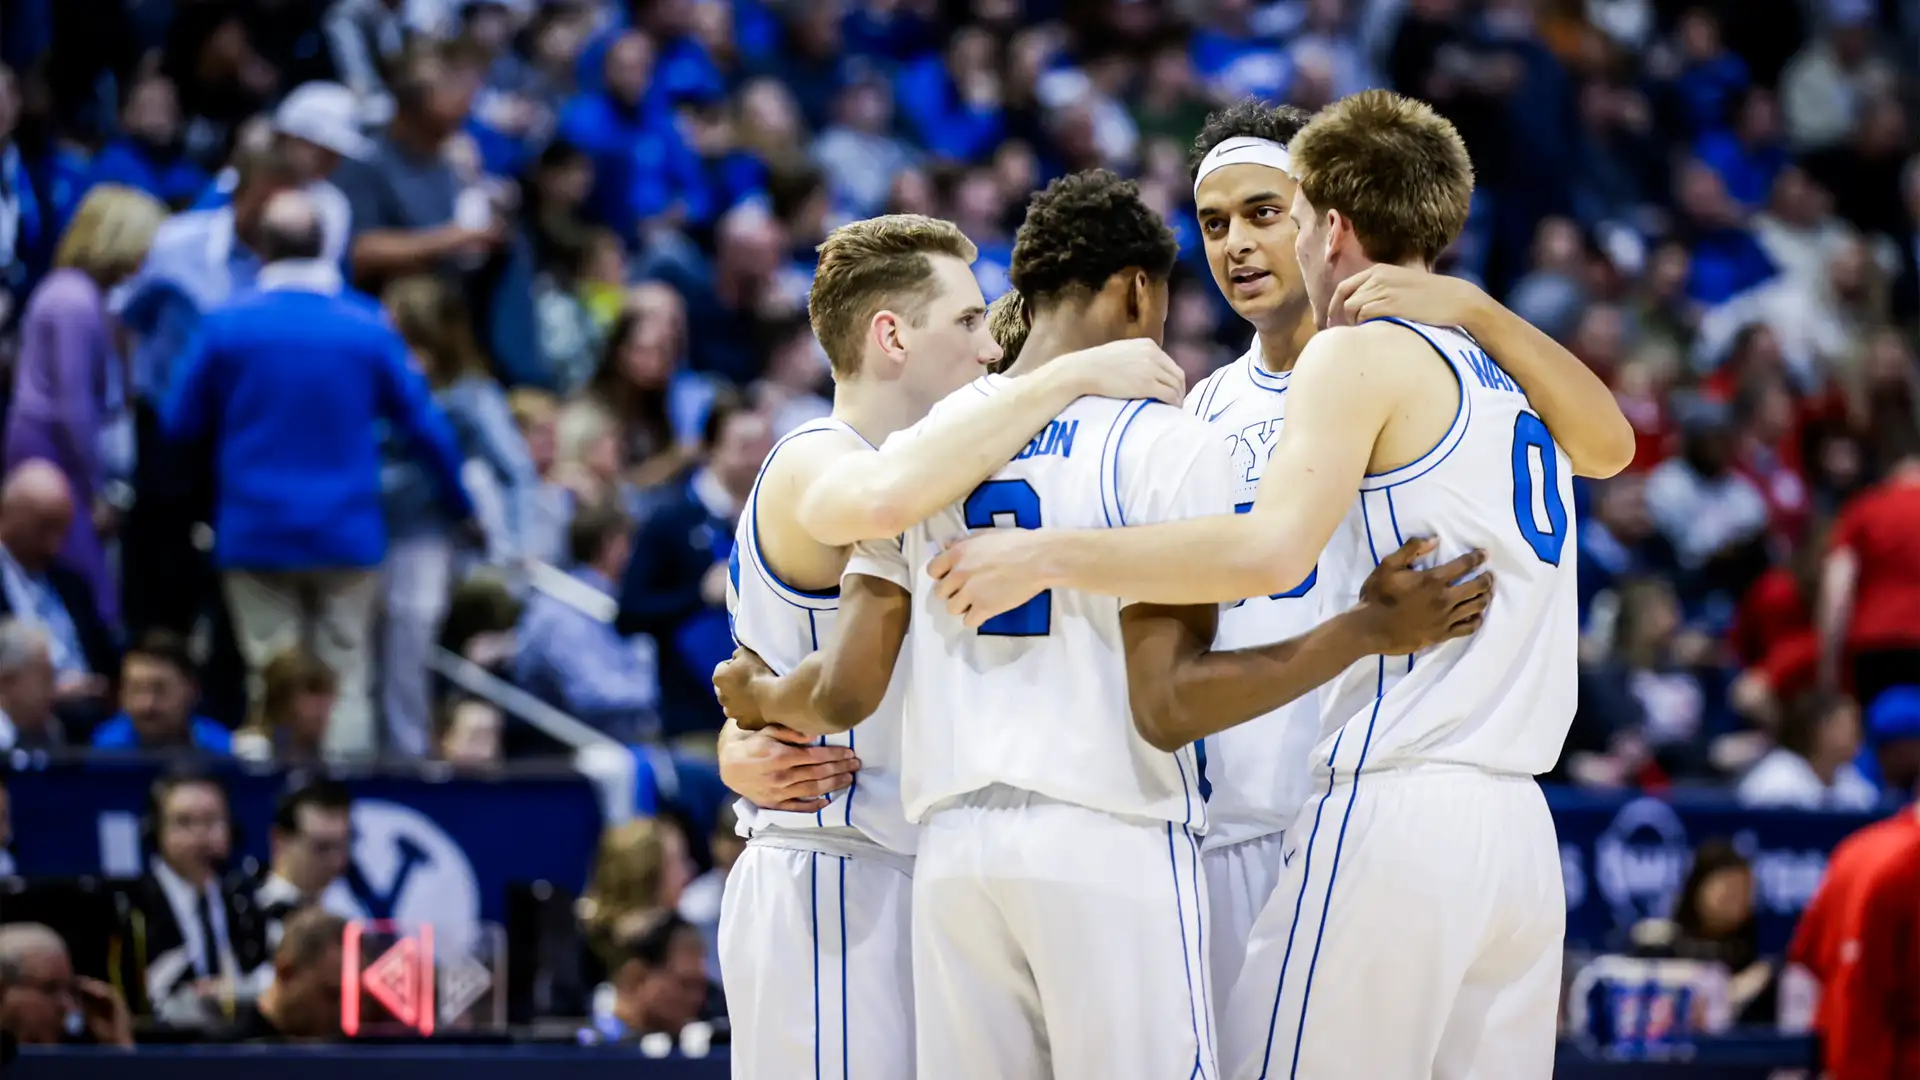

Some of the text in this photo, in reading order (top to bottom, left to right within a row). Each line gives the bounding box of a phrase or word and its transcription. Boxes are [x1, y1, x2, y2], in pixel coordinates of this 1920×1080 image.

[1459, 350, 1526, 394] WA
[963, 478, 1052, 637] 2
[1512, 410, 1568, 568] 0
